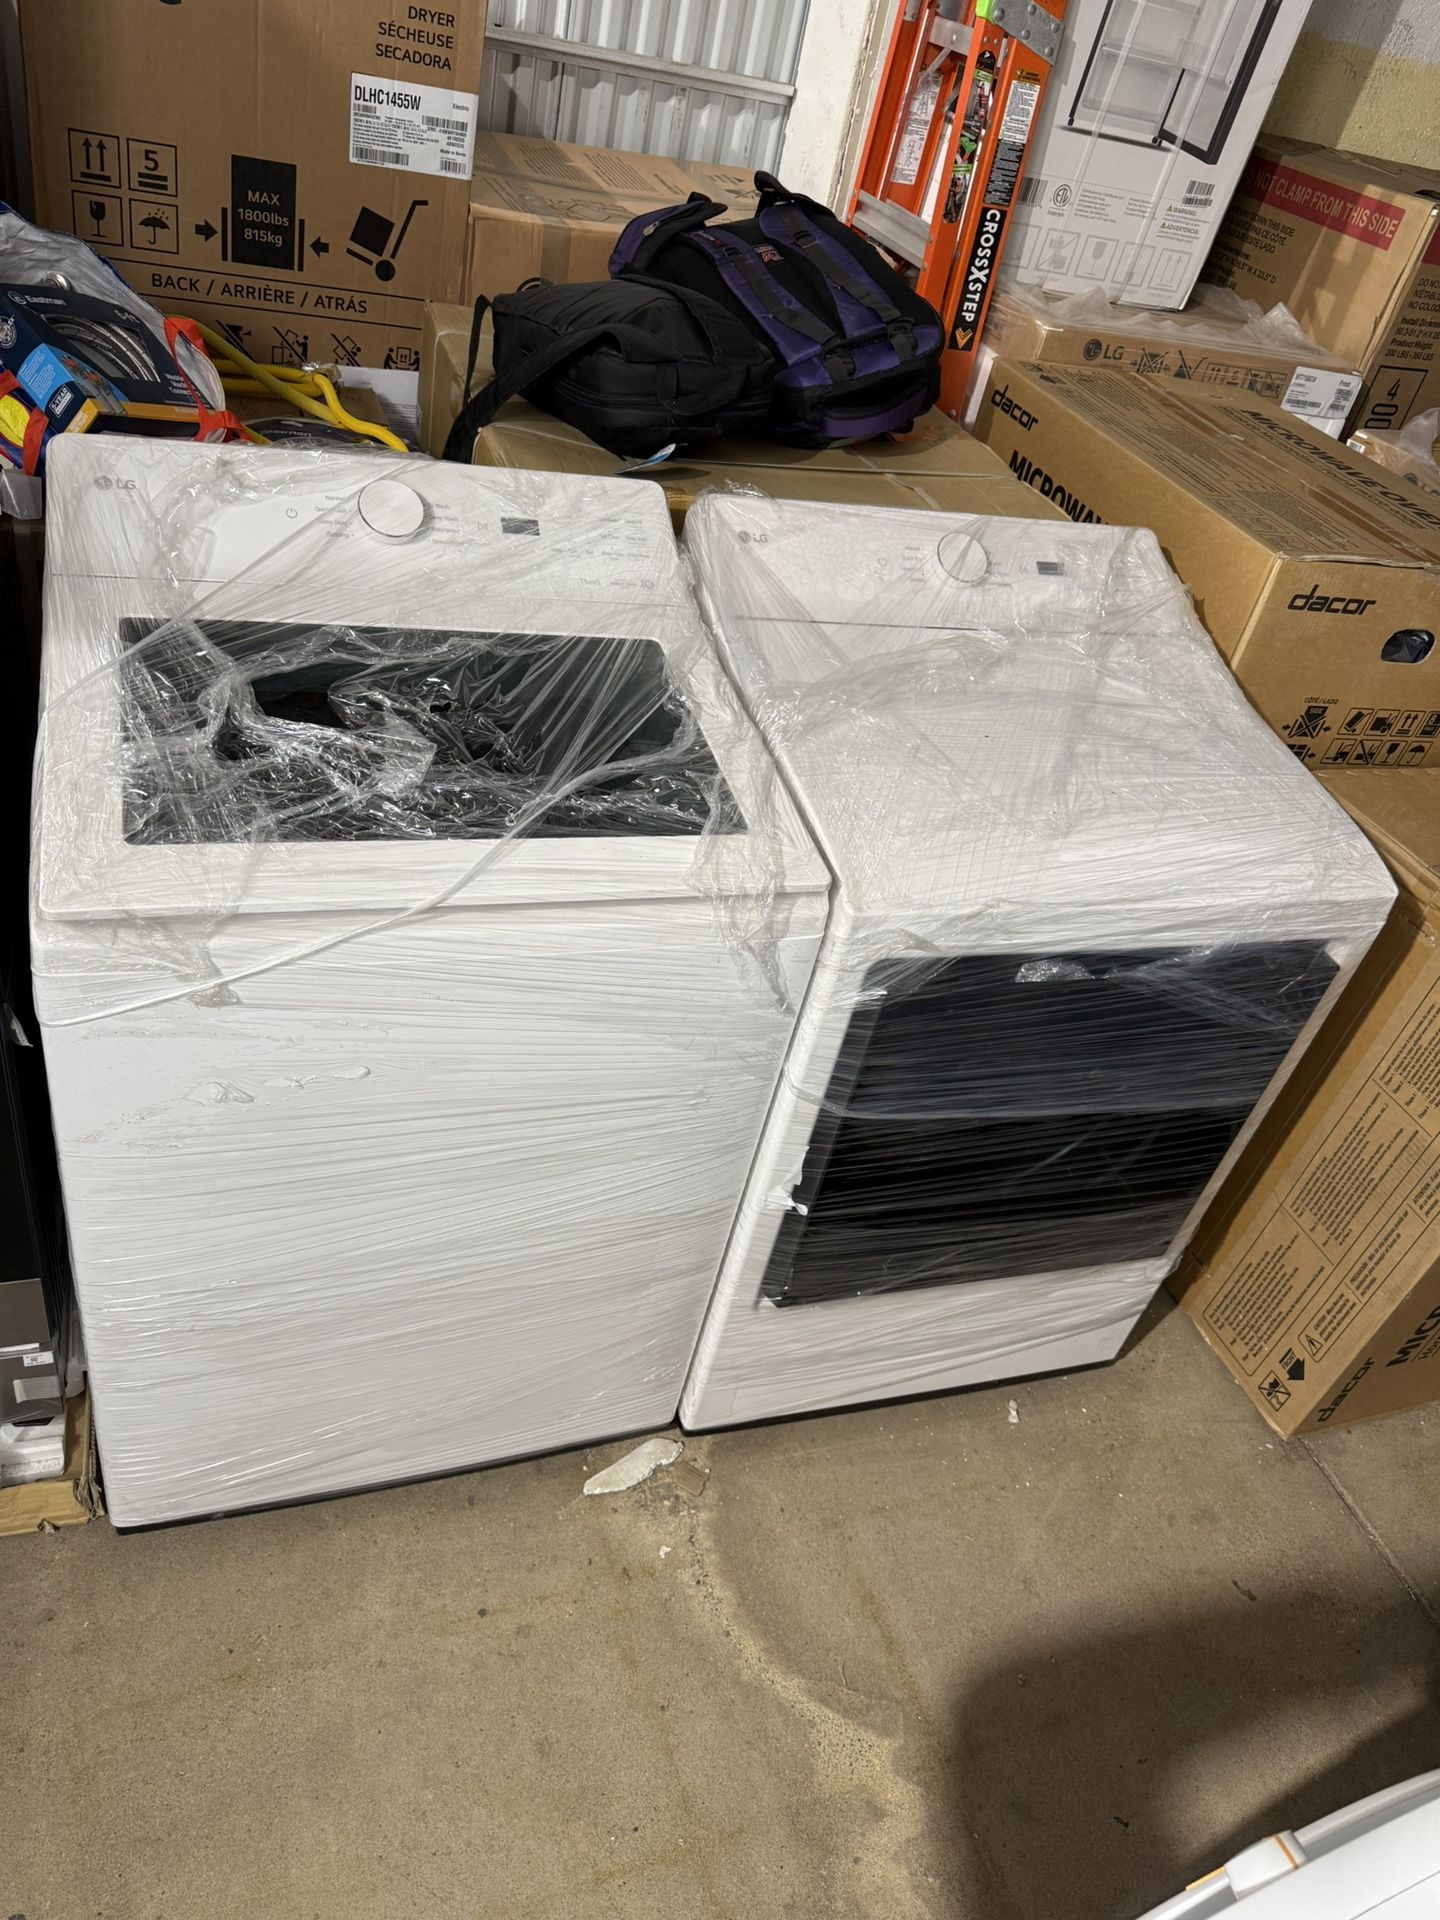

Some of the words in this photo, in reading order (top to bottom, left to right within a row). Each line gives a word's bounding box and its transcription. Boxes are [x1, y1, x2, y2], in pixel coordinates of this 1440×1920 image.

[408, 5, 455, 28] DRYER
[378, 20, 454, 49] SÉCHEUSE
[375, 43, 451, 71] SECADORA
[354, 85, 421, 111] DLHC1455W
[144, 149, 159, 172] 5
[247, 190, 280, 207] MAX
[1275, 178, 1312, 205] CLAMP
[1309, 191, 1345, 218] FROM
[1343, 203, 1370, 228] THIS
[1368, 212, 1399, 239] SIDE
[237, 208, 290, 227] 1800lbs
[244, 228, 283, 247] 815kg
[151, 273, 200, 294] BACK
[220, 282, 295, 306] ARRIÈRE
[314, 291, 368, 314] ATRÁS
[1103, 344, 1125, 361] LG
[1387, 378, 1401, 401] 4
[991, 384, 1039, 432] dacor
[1240, 409, 1389, 490] MICROWAVE
[116, 478, 136, 490] LG
[1287, 584, 1377, 616] dacor
[1318, 1357, 1375, 1423] dacor
